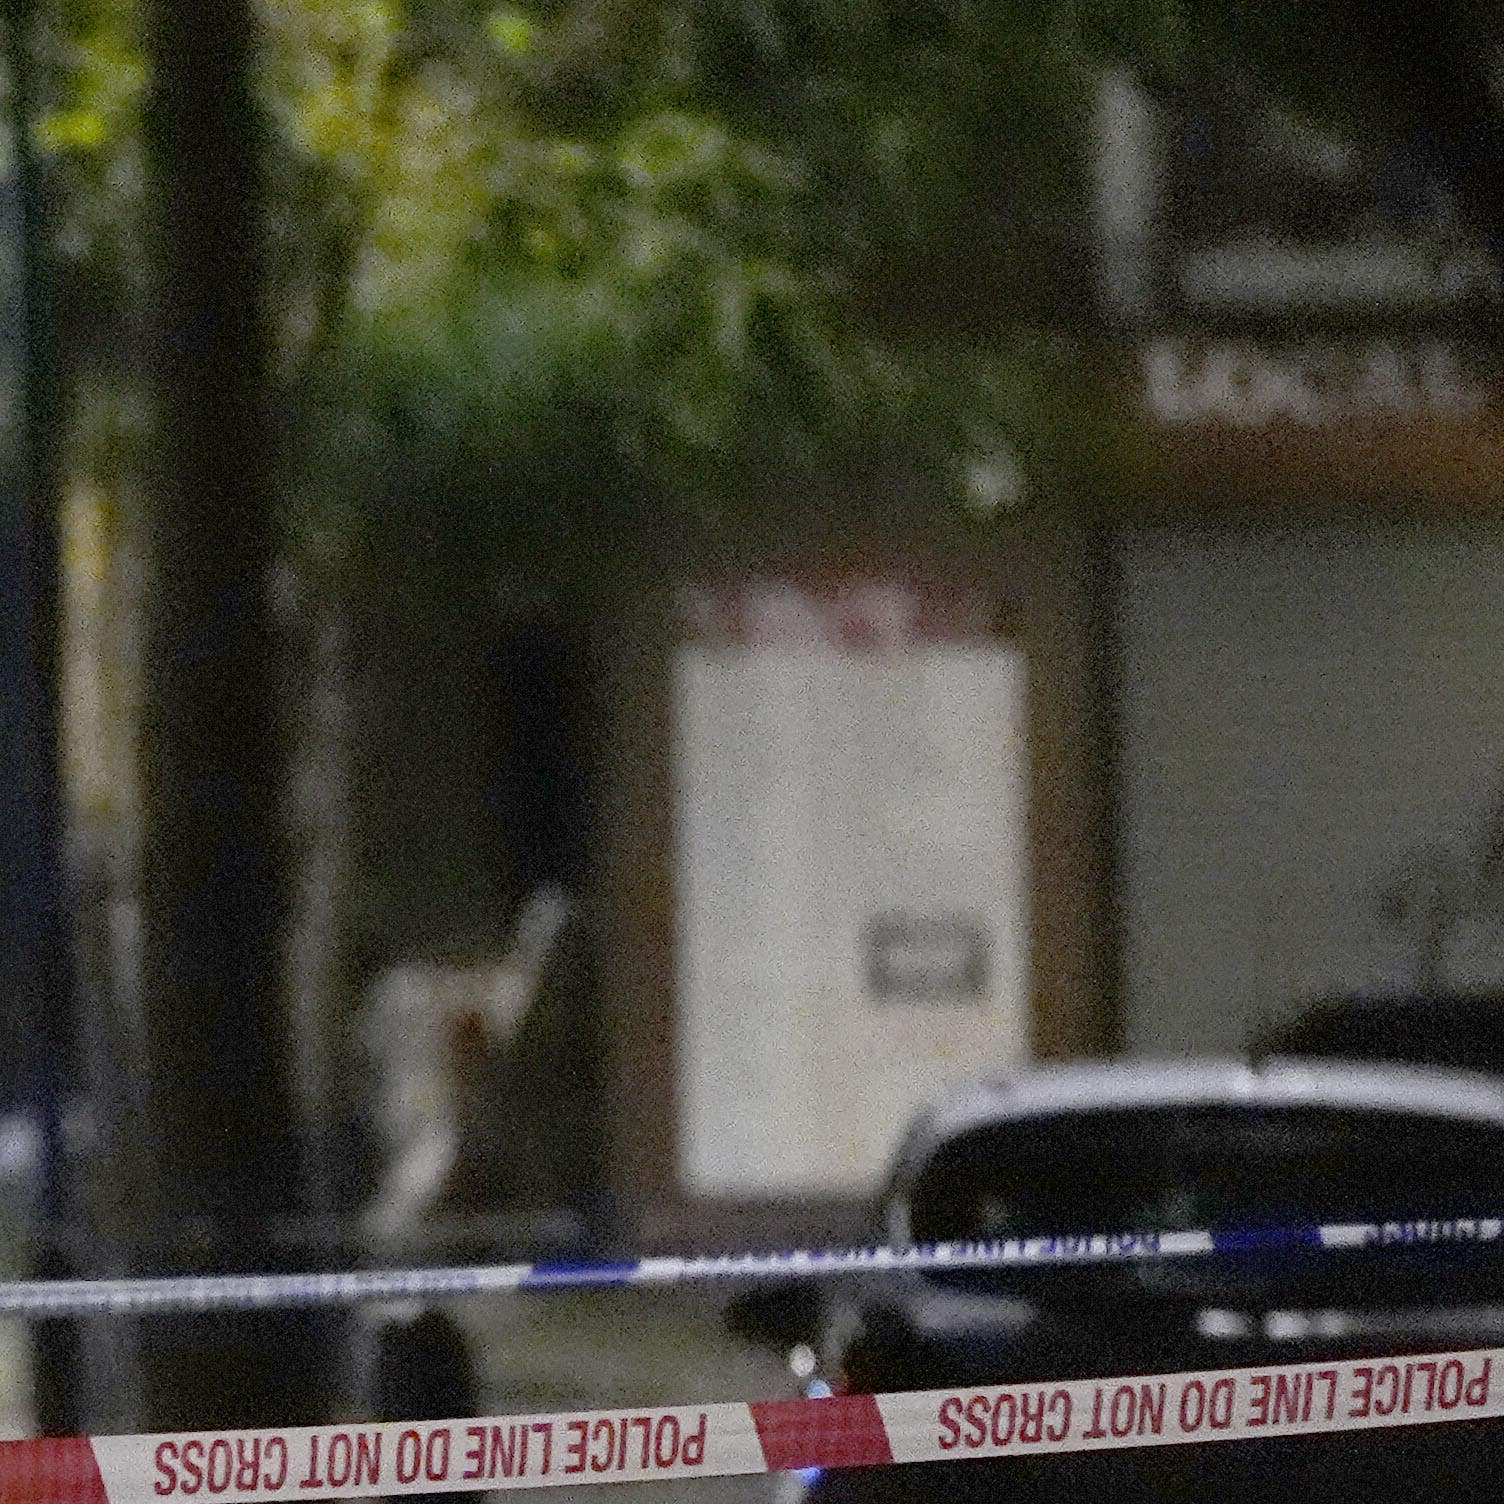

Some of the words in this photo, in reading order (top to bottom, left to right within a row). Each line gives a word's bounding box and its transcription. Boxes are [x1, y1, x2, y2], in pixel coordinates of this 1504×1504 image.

[1083, 1384, 1166, 1441] NOT
[1179, 1378, 1233, 1435] DO
[1247, 1370, 1338, 1427] LINE
[1350, 1359, 1493, 1416] POLICE
[565, 1415, 708, 1473] POLICE
[938, 1392, 1074, 1449] CROSS
[154, 1436, 288, 1496] CROSS
[300, 1430, 382, 1489] NOT
[395, 1428, 450, 1484] DO
[464, 1422, 553, 1481] LINE
